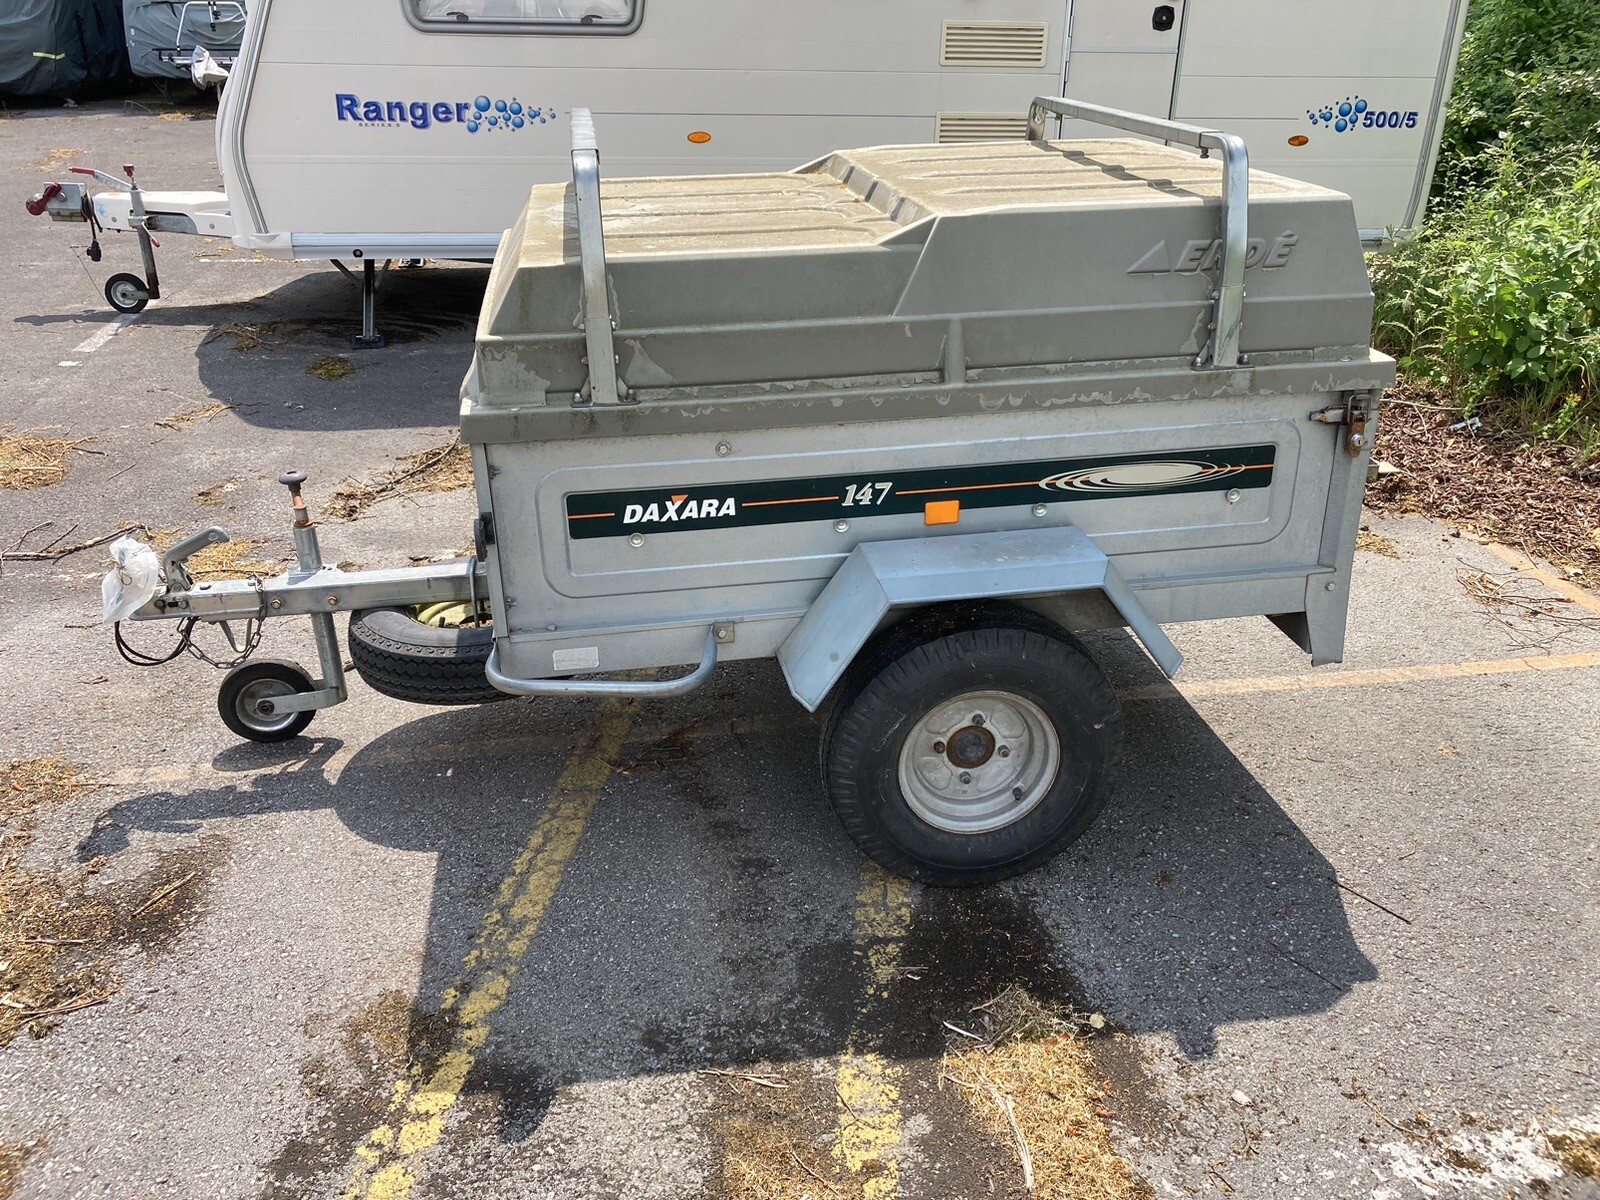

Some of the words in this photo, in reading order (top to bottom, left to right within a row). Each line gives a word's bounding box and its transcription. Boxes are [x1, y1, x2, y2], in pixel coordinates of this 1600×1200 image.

[335, 93, 471, 130] Ranger
[1362, 111, 1419, 129] 500/5
[622, 497, 737, 524] DAXARA
[841, 481, 893, 507] 147
